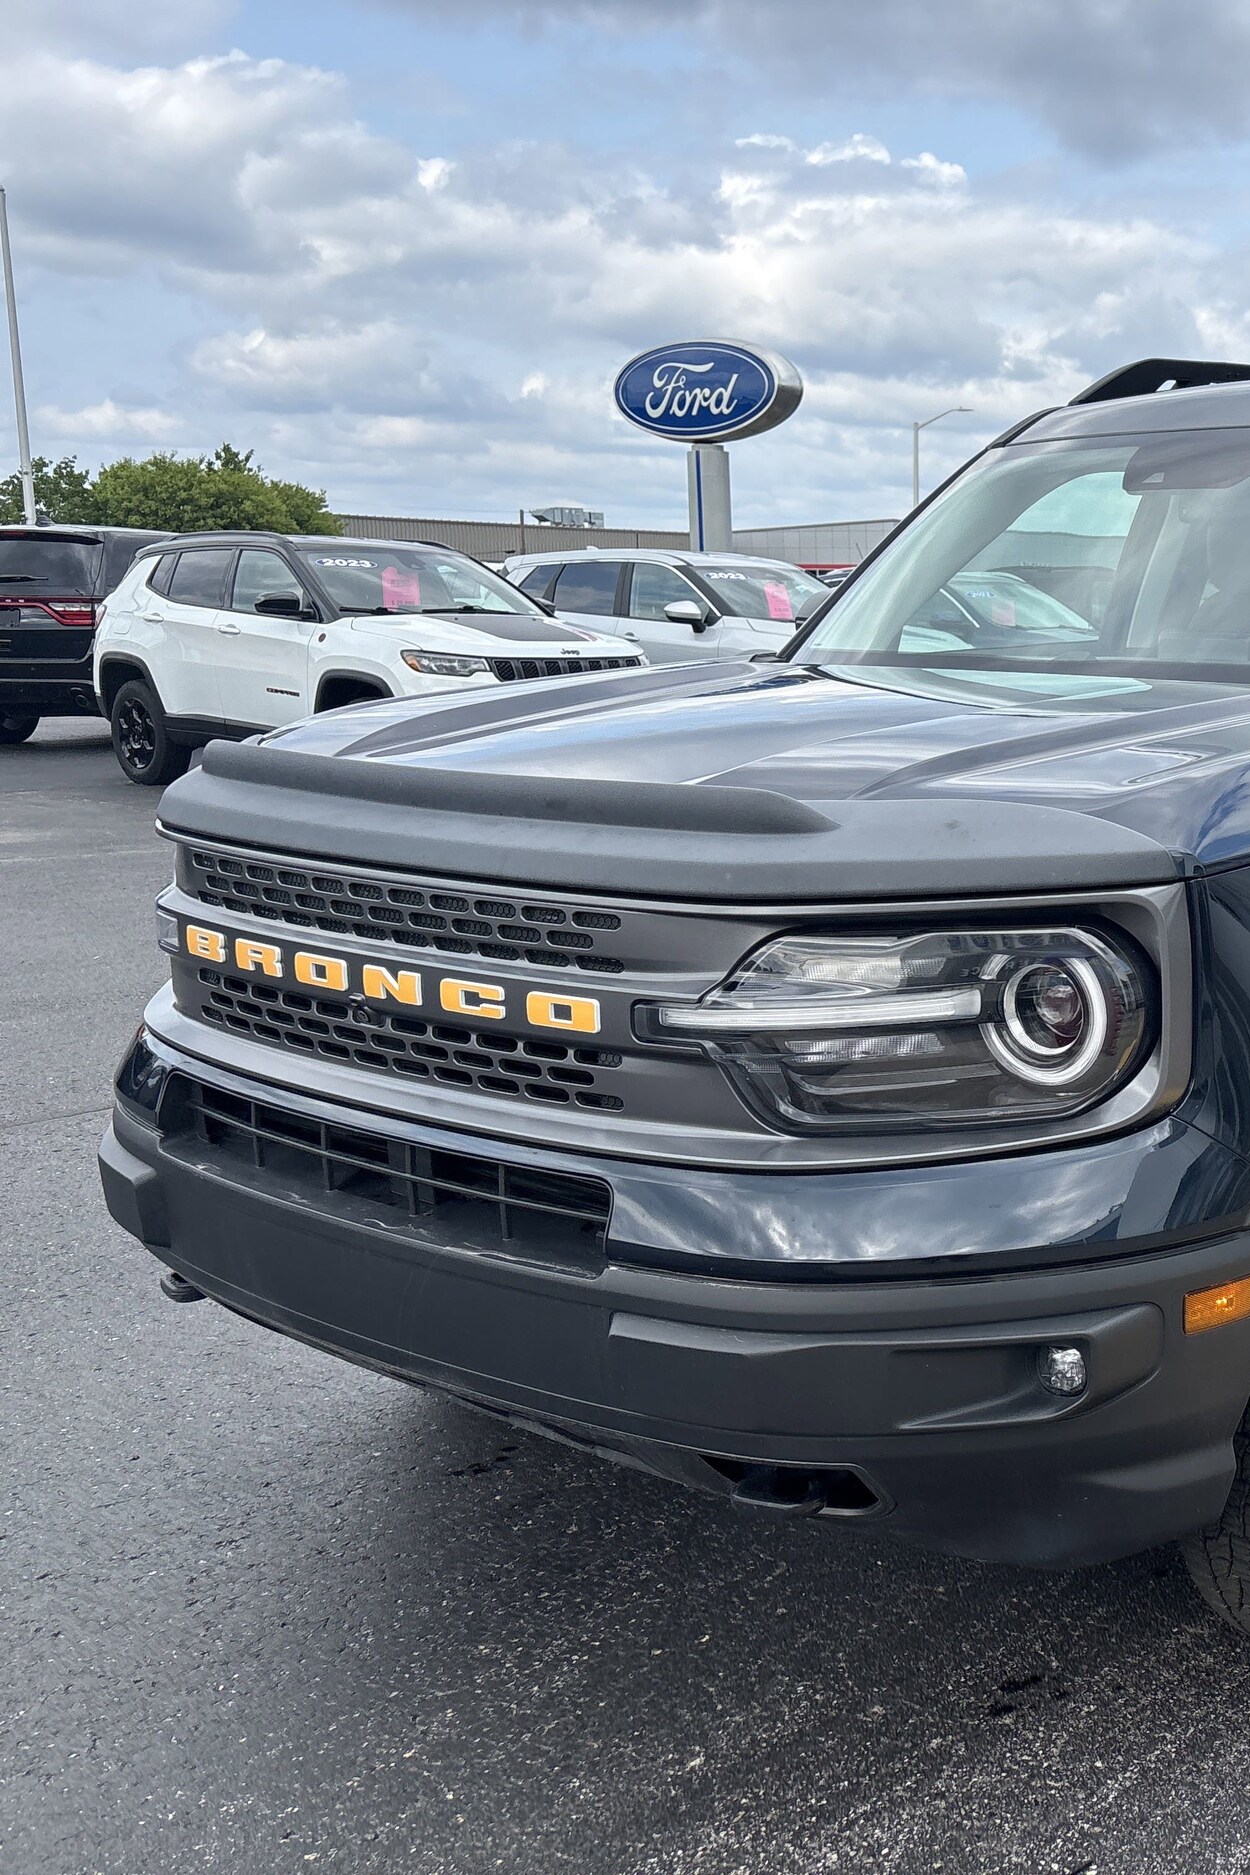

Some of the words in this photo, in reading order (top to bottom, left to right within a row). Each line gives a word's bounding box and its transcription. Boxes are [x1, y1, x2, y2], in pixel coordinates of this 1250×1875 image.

[645, 362, 739, 418] Ford
[322, 558, 372, 568] 2023
[709, 572, 746, 580] 2023
[560, 648, 580, 656] Jeep
[186, 925, 601, 1034] BRONCO
